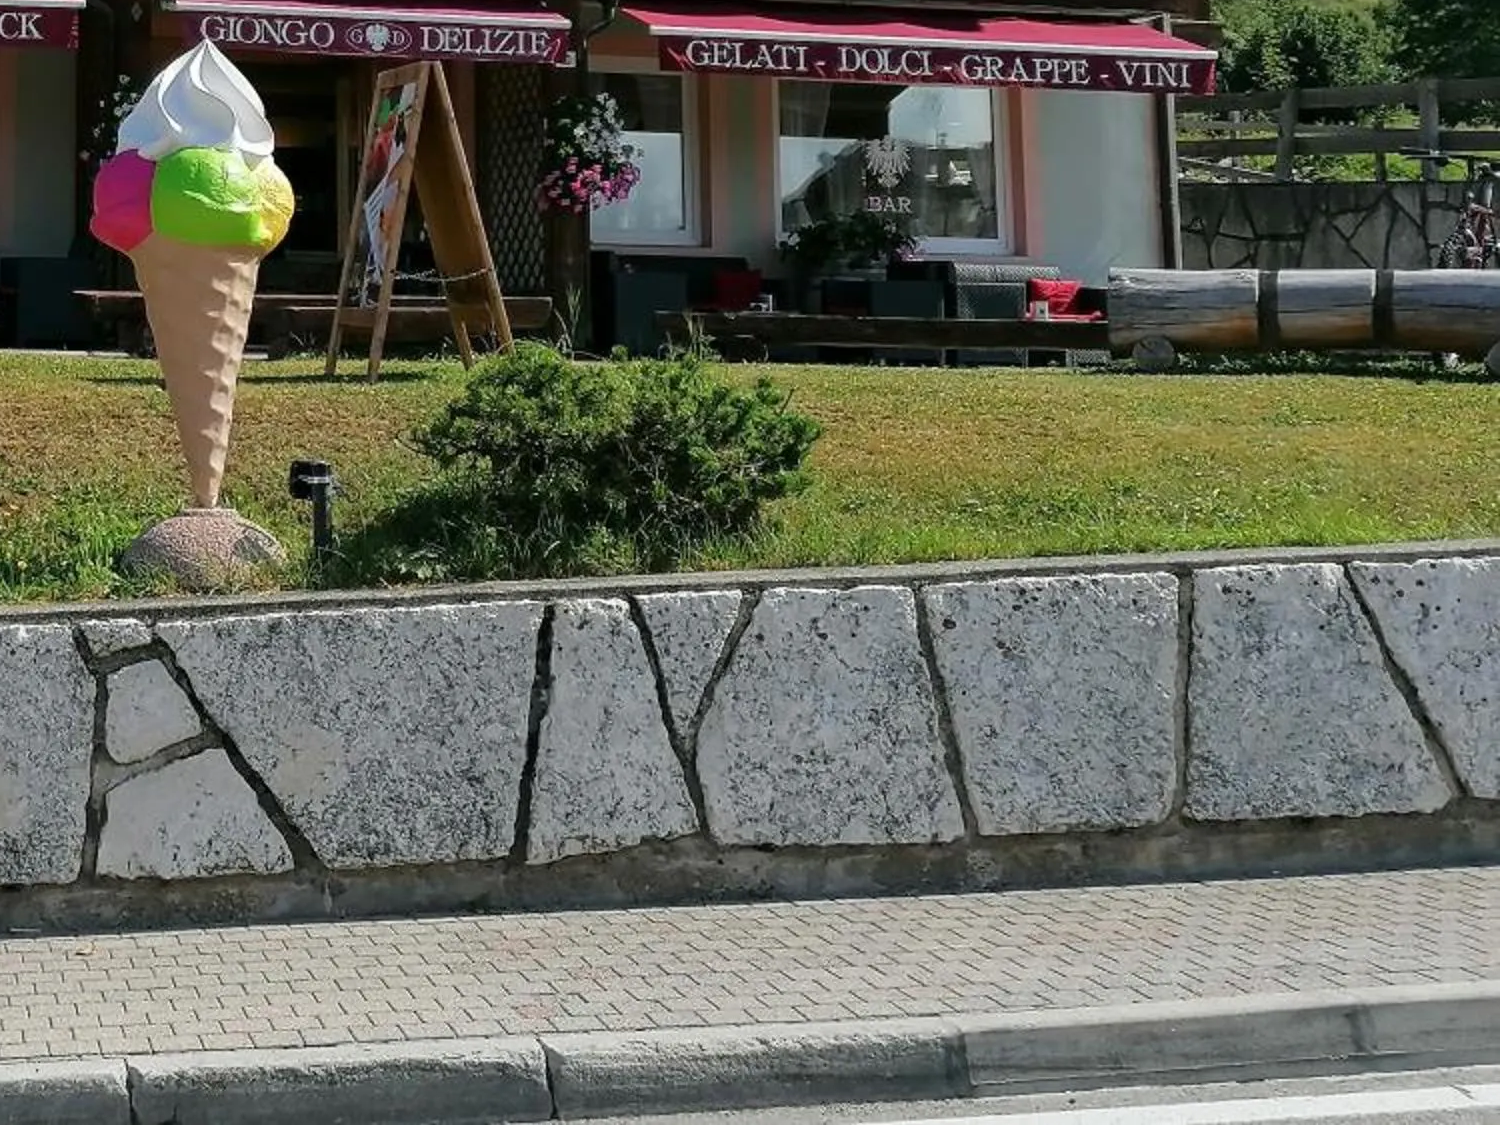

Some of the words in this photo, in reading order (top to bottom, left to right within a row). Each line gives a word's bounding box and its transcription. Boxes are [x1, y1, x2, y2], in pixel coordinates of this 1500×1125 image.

[200, 15, 335, 48] GIONGO
[420, 25, 552, 57] DELIZIE
[685, 40, 808, 72] GELATI
[837, 46, 934, 76] DOLCI
[960, 55, 1092, 85] GRAPPE
[1116, 60, 1192, 88] VINI
[866, 196, 912, 213] BAR
